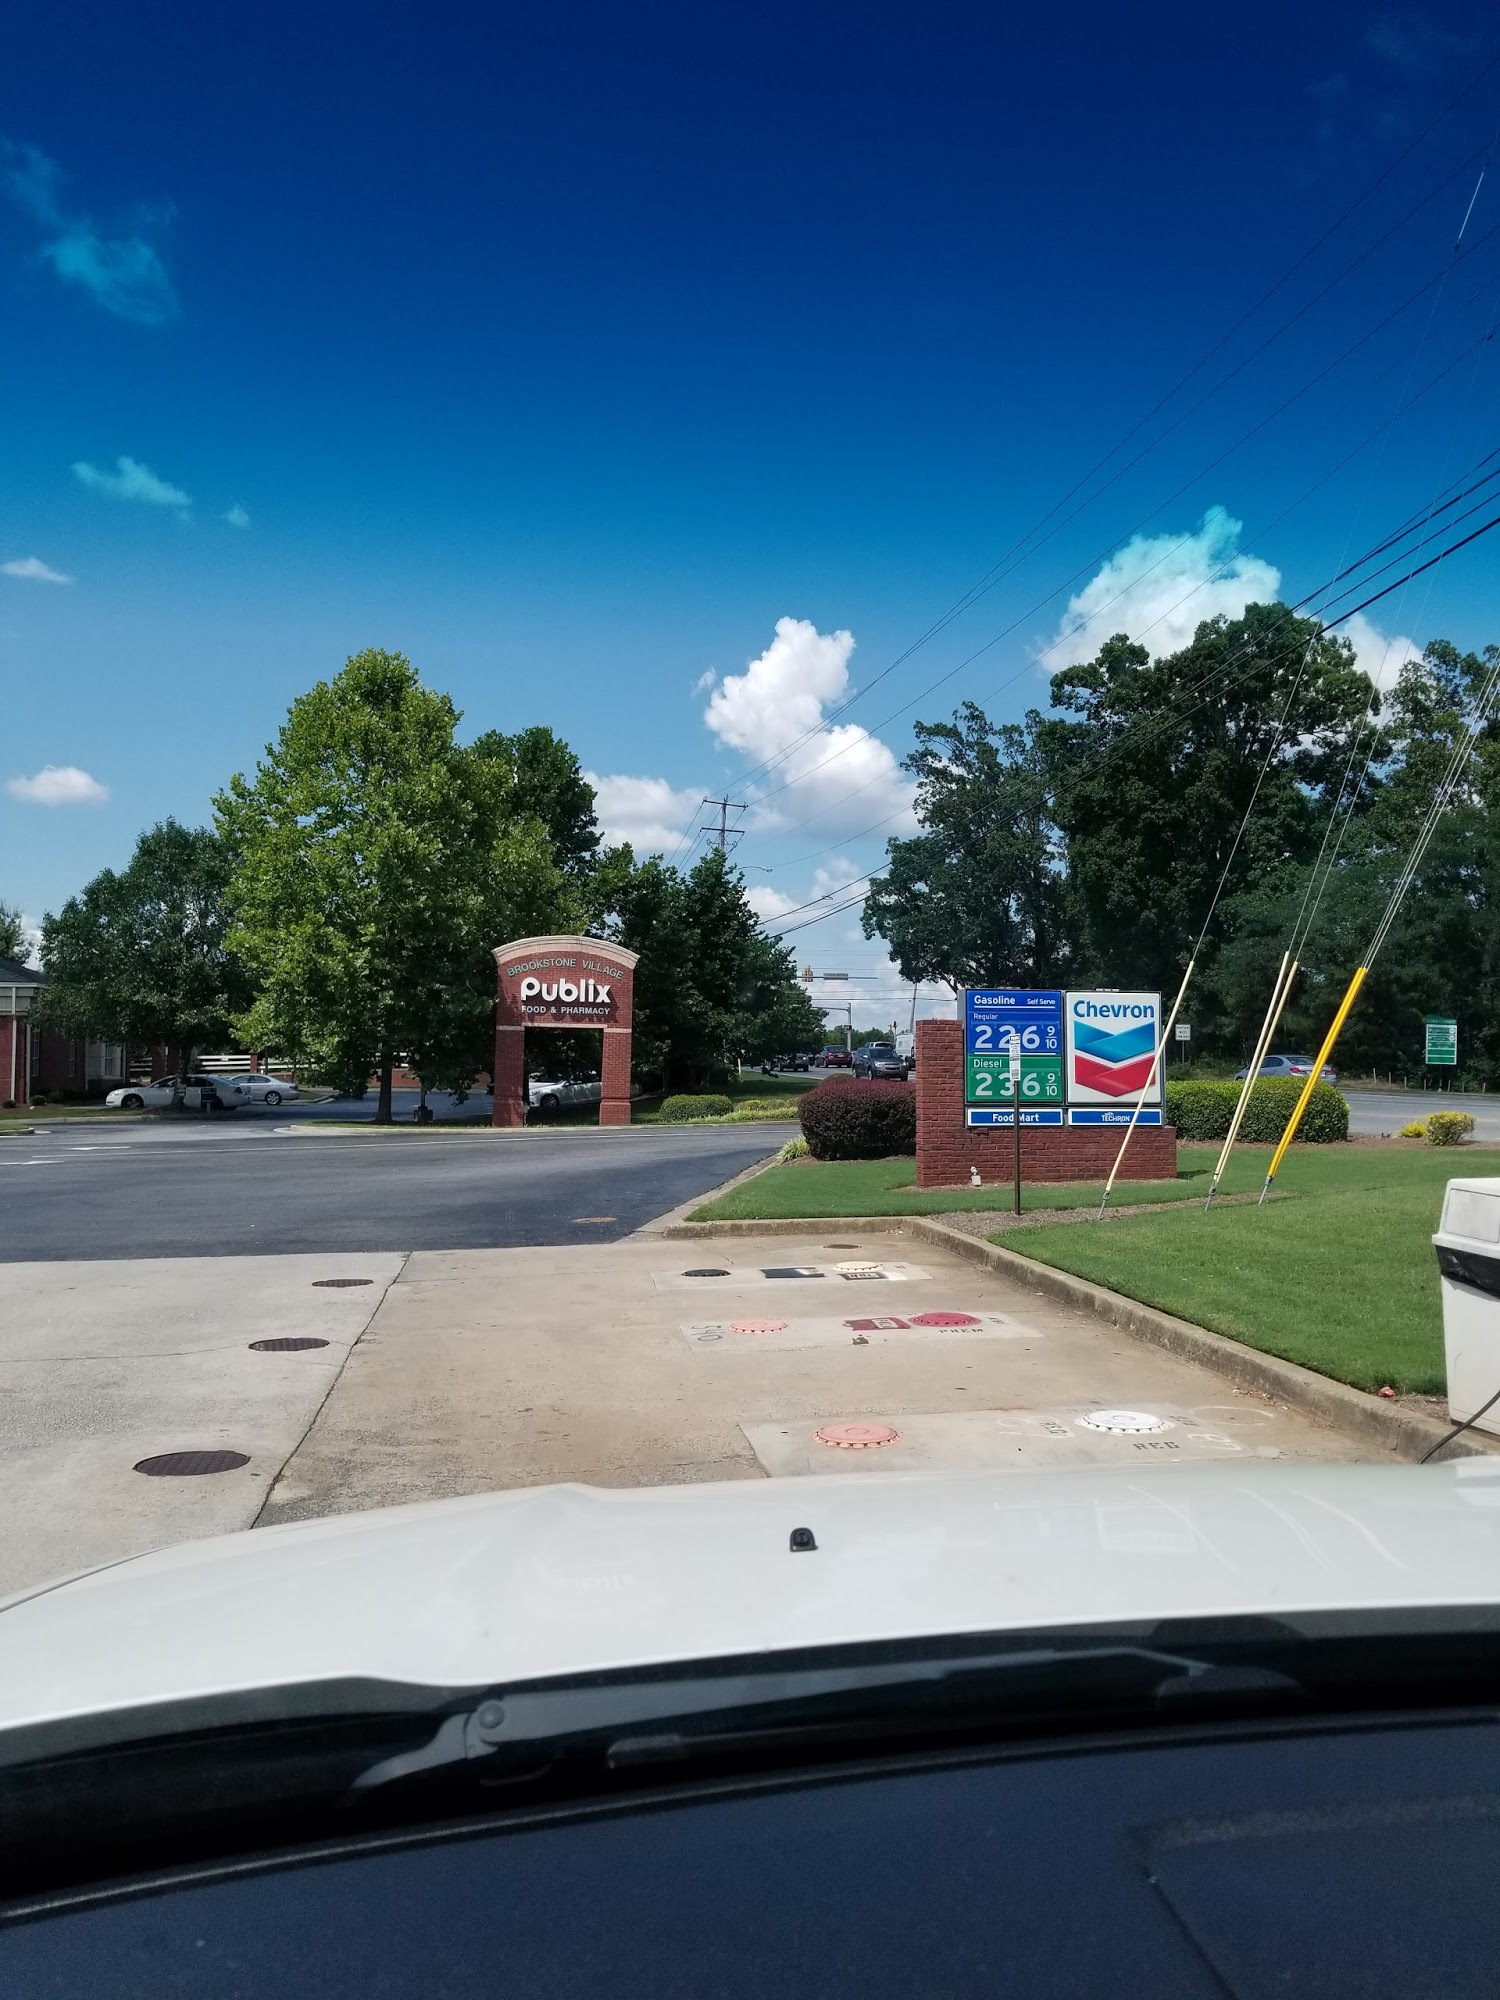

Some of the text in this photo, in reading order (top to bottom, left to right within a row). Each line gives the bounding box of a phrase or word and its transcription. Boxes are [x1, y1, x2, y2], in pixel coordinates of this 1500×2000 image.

[507, 958, 624, 979] BROOKSTONE VILLAGE
[520, 977, 611, 1003] Publix
[974, 995, 1016, 1005] Gasoline
[521, 1006, 610, 1015] FOOD & PHARMACY
[1073, 999, 1155, 1019] Chevron
[973, 1013, 998, 1021] Regular
[973, 1058, 1002, 1068] Diesel
[992, 1113, 1014, 1122] Food
[1101, 1114, 1130, 1122] TECHRON
[1132, 1441, 1180, 1451] REG
